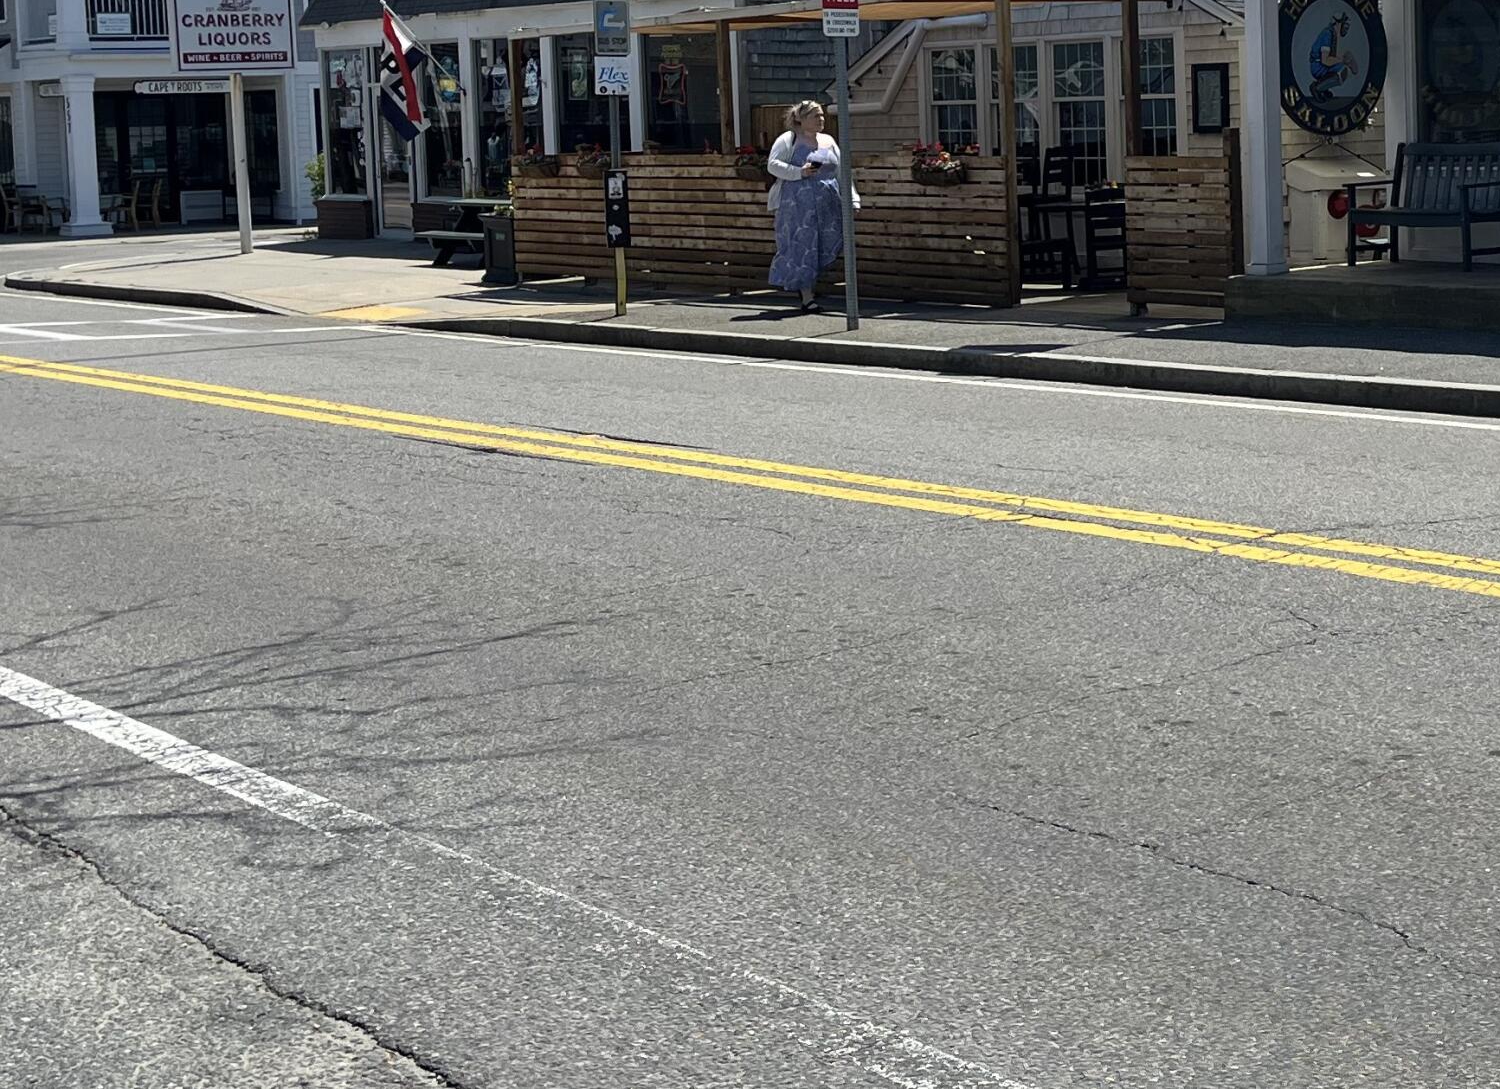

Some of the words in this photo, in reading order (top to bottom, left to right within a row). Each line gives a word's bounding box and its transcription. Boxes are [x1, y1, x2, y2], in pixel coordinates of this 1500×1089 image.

[181, 13, 285, 28] CRANBERRY
[198, 32, 271, 47] LIQUORS
[186, 53, 211, 63] WINE
[219, 53, 242, 62] BEER
[250, 52, 284, 61] SPIRITS
[598, 66, 629, 81] Flex
[148, 81, 169, 93] CAPE
[176, 81, 202, 92] ROOTS
[1283, 81, 1380, 132] SALOON
